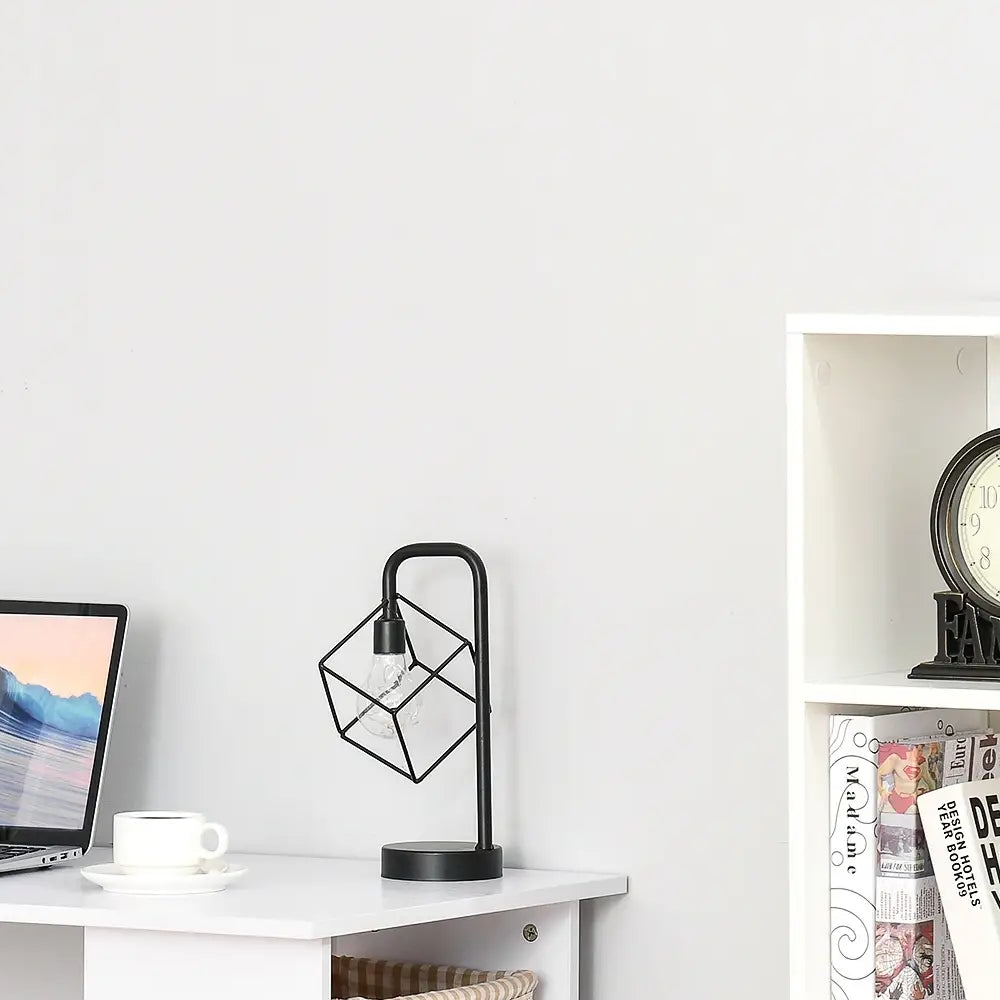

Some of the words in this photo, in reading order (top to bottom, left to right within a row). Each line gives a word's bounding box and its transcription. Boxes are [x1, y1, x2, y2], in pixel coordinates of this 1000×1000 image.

[970, 513, 981, 537] 9
[979, 546, 991, 570] 8
[937, 803, 954, 839] YEAR
[946, 800, 967, 851] DESIGN
[960, 854, 981, 907] HOTELS
